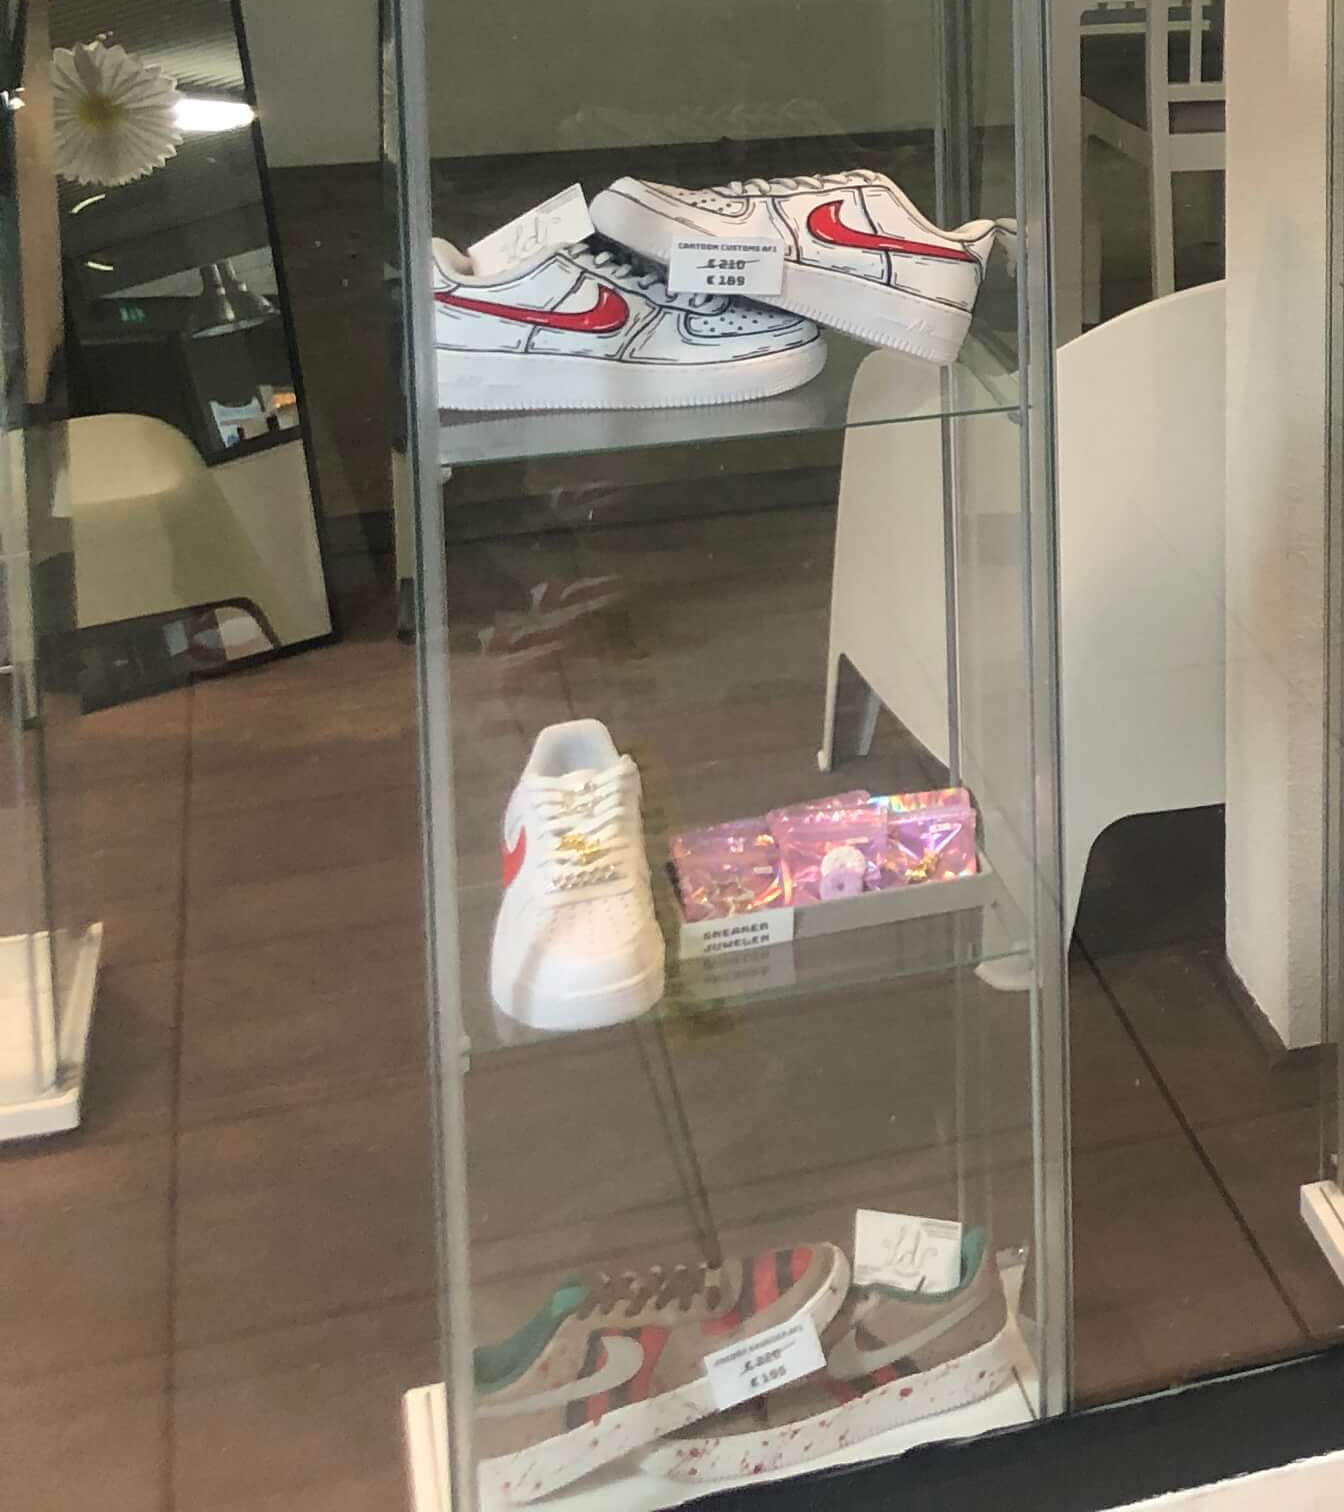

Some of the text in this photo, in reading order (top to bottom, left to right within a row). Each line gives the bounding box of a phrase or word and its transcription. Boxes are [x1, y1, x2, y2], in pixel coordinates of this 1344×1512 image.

[721, 244, 760, 252] CUSTOMS
[719, 259, 745, 270] 210
[718, 275, 745, 286] 189
